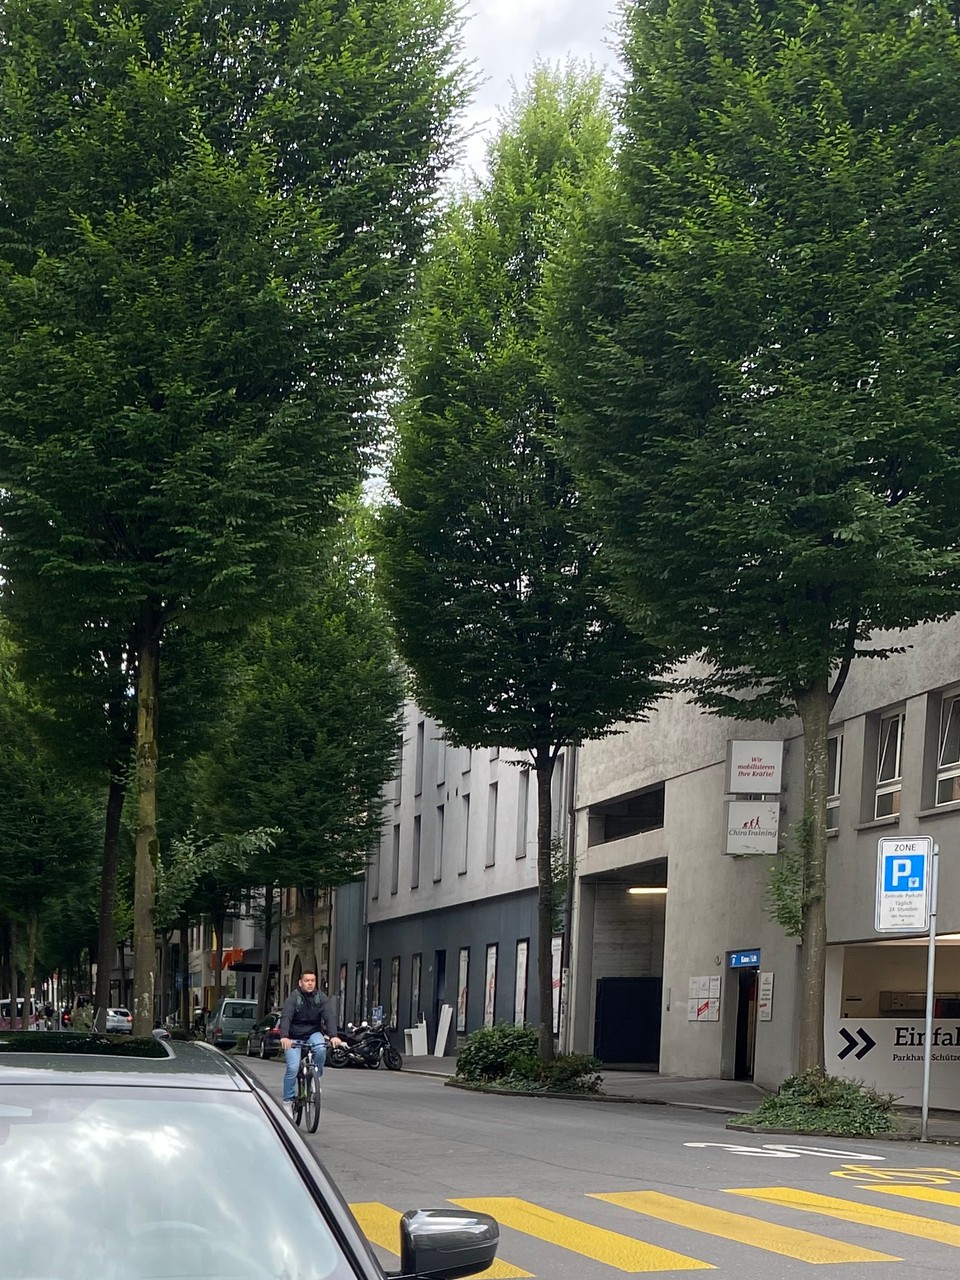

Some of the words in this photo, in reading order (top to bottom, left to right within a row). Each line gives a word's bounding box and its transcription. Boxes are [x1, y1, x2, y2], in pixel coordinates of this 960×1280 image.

[894, 844, 916, 852] ZONE
[892, 859, 912, 887] P
[893, 1053, 926, 1062] Parkhau
